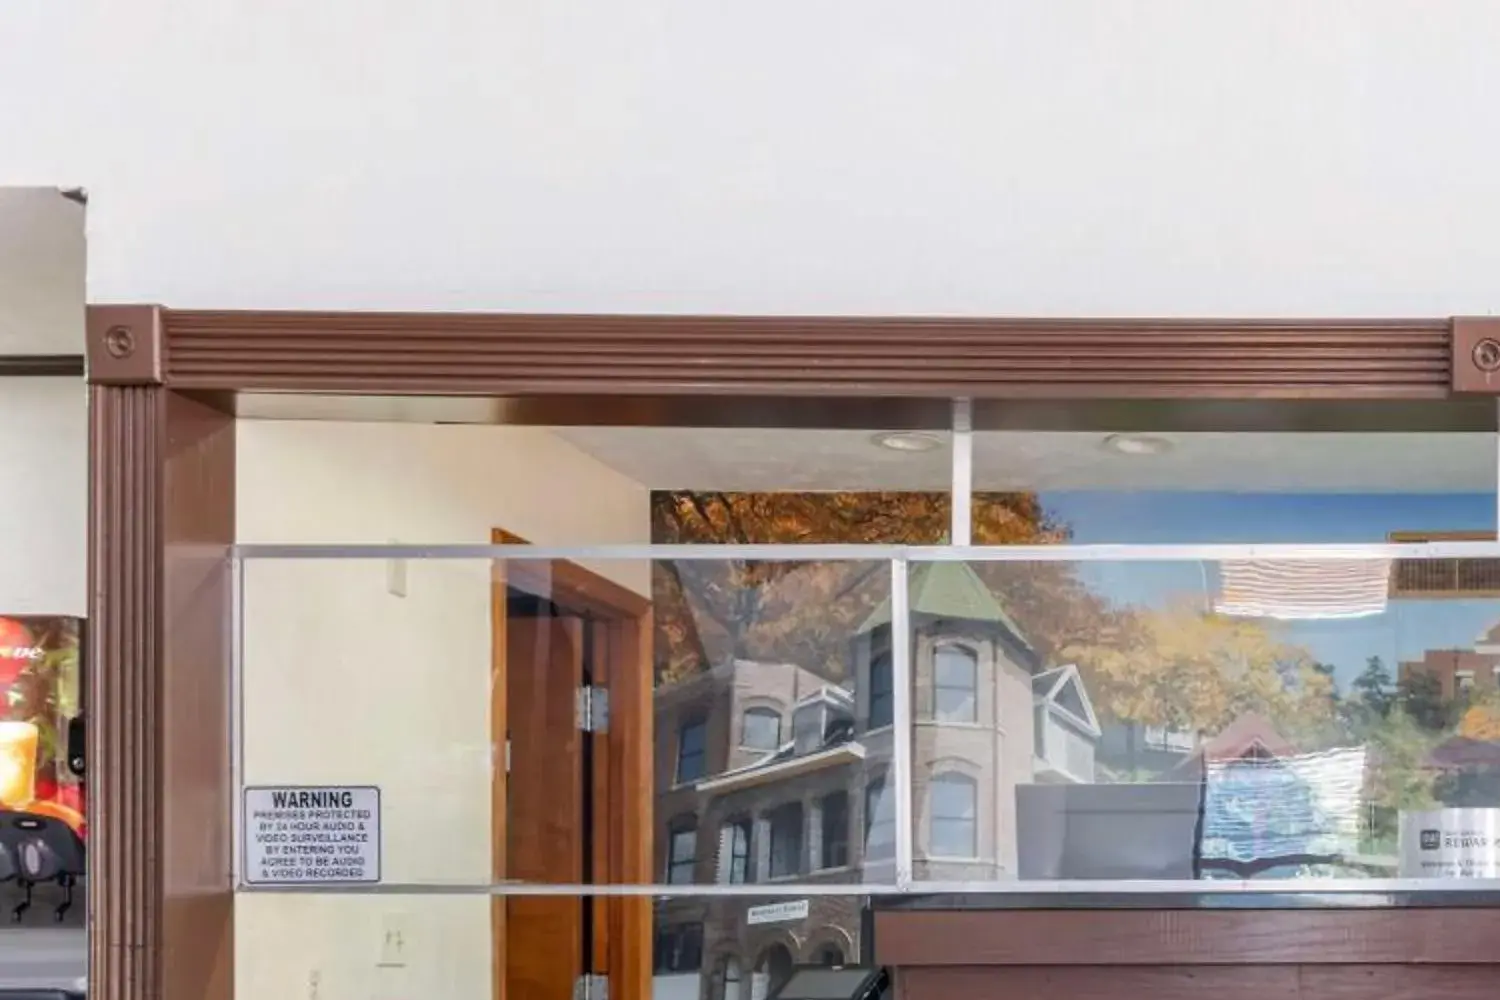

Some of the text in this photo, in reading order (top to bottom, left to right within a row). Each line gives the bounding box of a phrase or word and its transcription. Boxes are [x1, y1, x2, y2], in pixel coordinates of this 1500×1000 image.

[272, 791, 353, 808] WARNING
[253, 809, 371, 819] PREMISES PROTECTED
[260, 821, 365, 831] BY 24 HOUR AUDIO &
[256, 833, 368, 843] VIDEO SURVEILLANCE
[266, 845, 359, 855] BY ENTERING YOU
[261, 857, 365, 867] AGREE TO BE AUDIO
[262, 868, 363, 878] & VIDEO RECORDED
